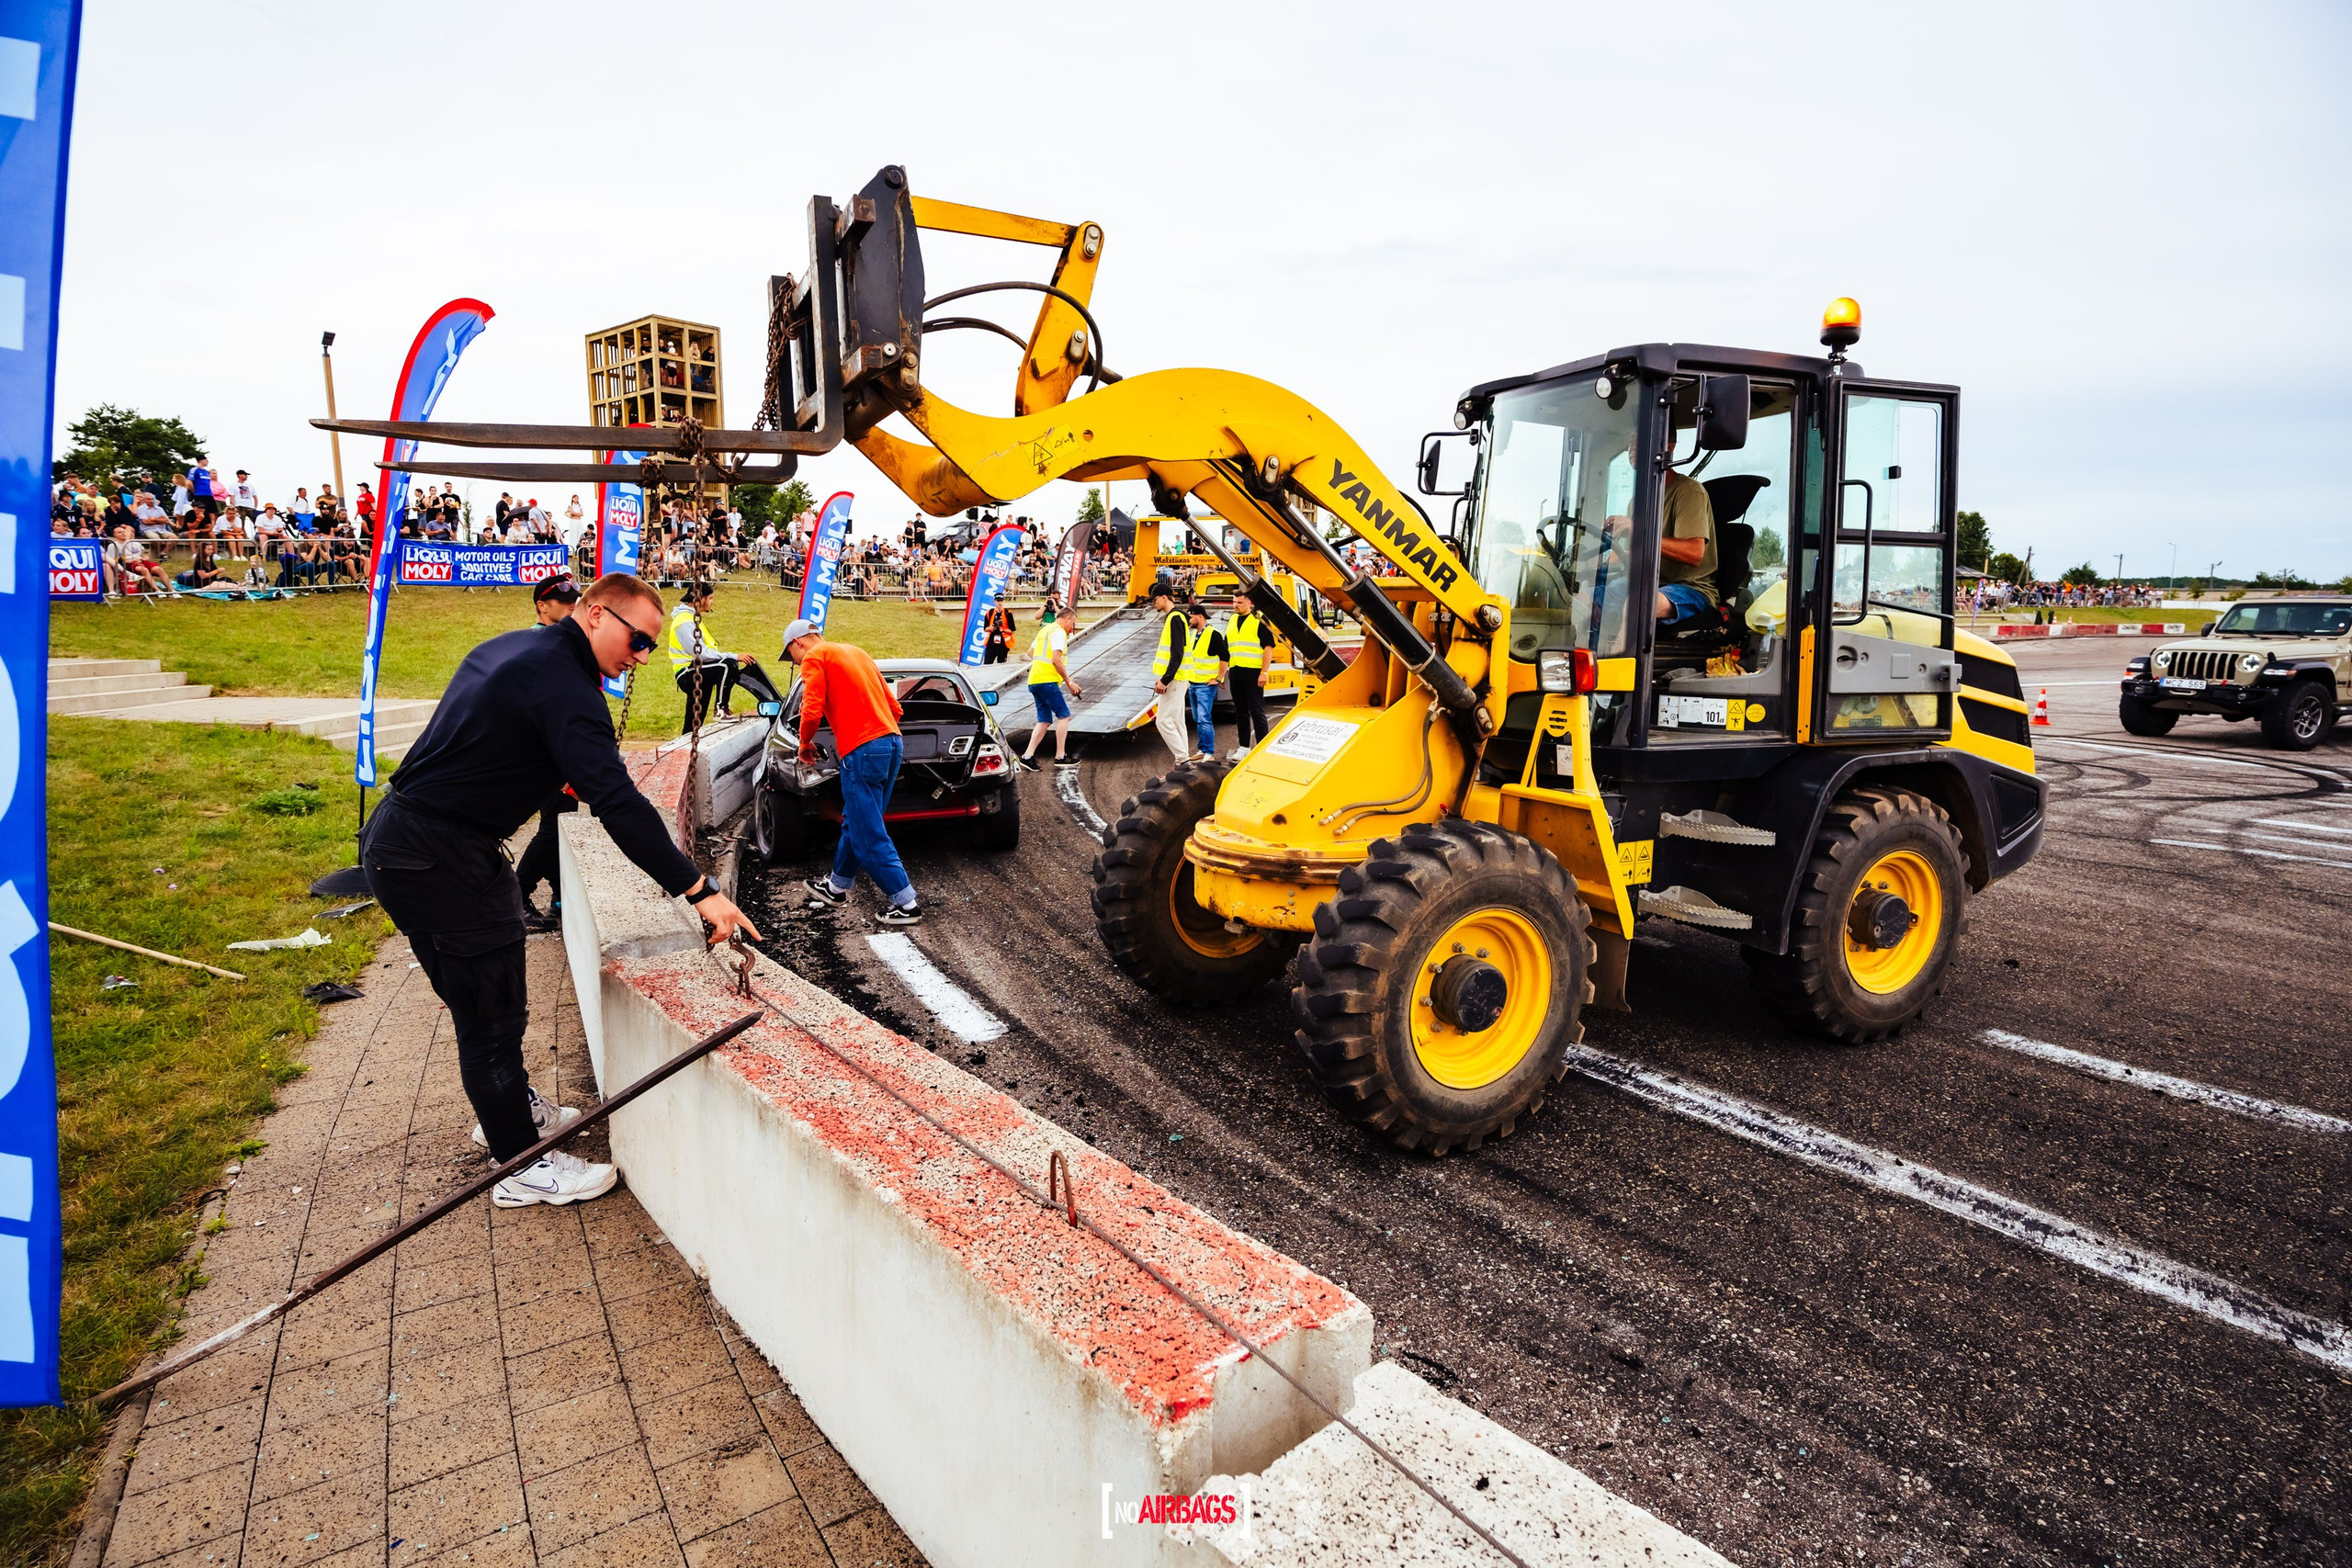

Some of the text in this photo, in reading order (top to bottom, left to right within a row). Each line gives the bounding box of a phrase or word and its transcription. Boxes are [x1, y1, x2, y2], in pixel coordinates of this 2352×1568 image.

[611, 498, 637, 513] LIQUI
[610, 511, 637, 528] MOLY
[1329, 457, 1458, 592] YANMAR
[817, 504, 848, 586] MLY
[819, 536, 840, 551] LIQUI
[50, 548, 95, 570] QUI
[405, 547, 451, 563] LIQUI
[455, 552, 516, 562] MOTOR OILS
[522, 551, 562, 565] LIQUI
[817, 547, 839, 560] MOLY
[460, 563, 513, 573] ADDITIVES
[985, 534, 1016, 597] MLY
[986, 558, 1008, 570] LIQUI
[404, 563, 451, 581] MOLY
[460, 571, 482, 581] CAR
[984, 566, 1006, 579] MOLY
[2188, 680, 2205, 689] 565
[1706, 711, 1720, 723] 101
